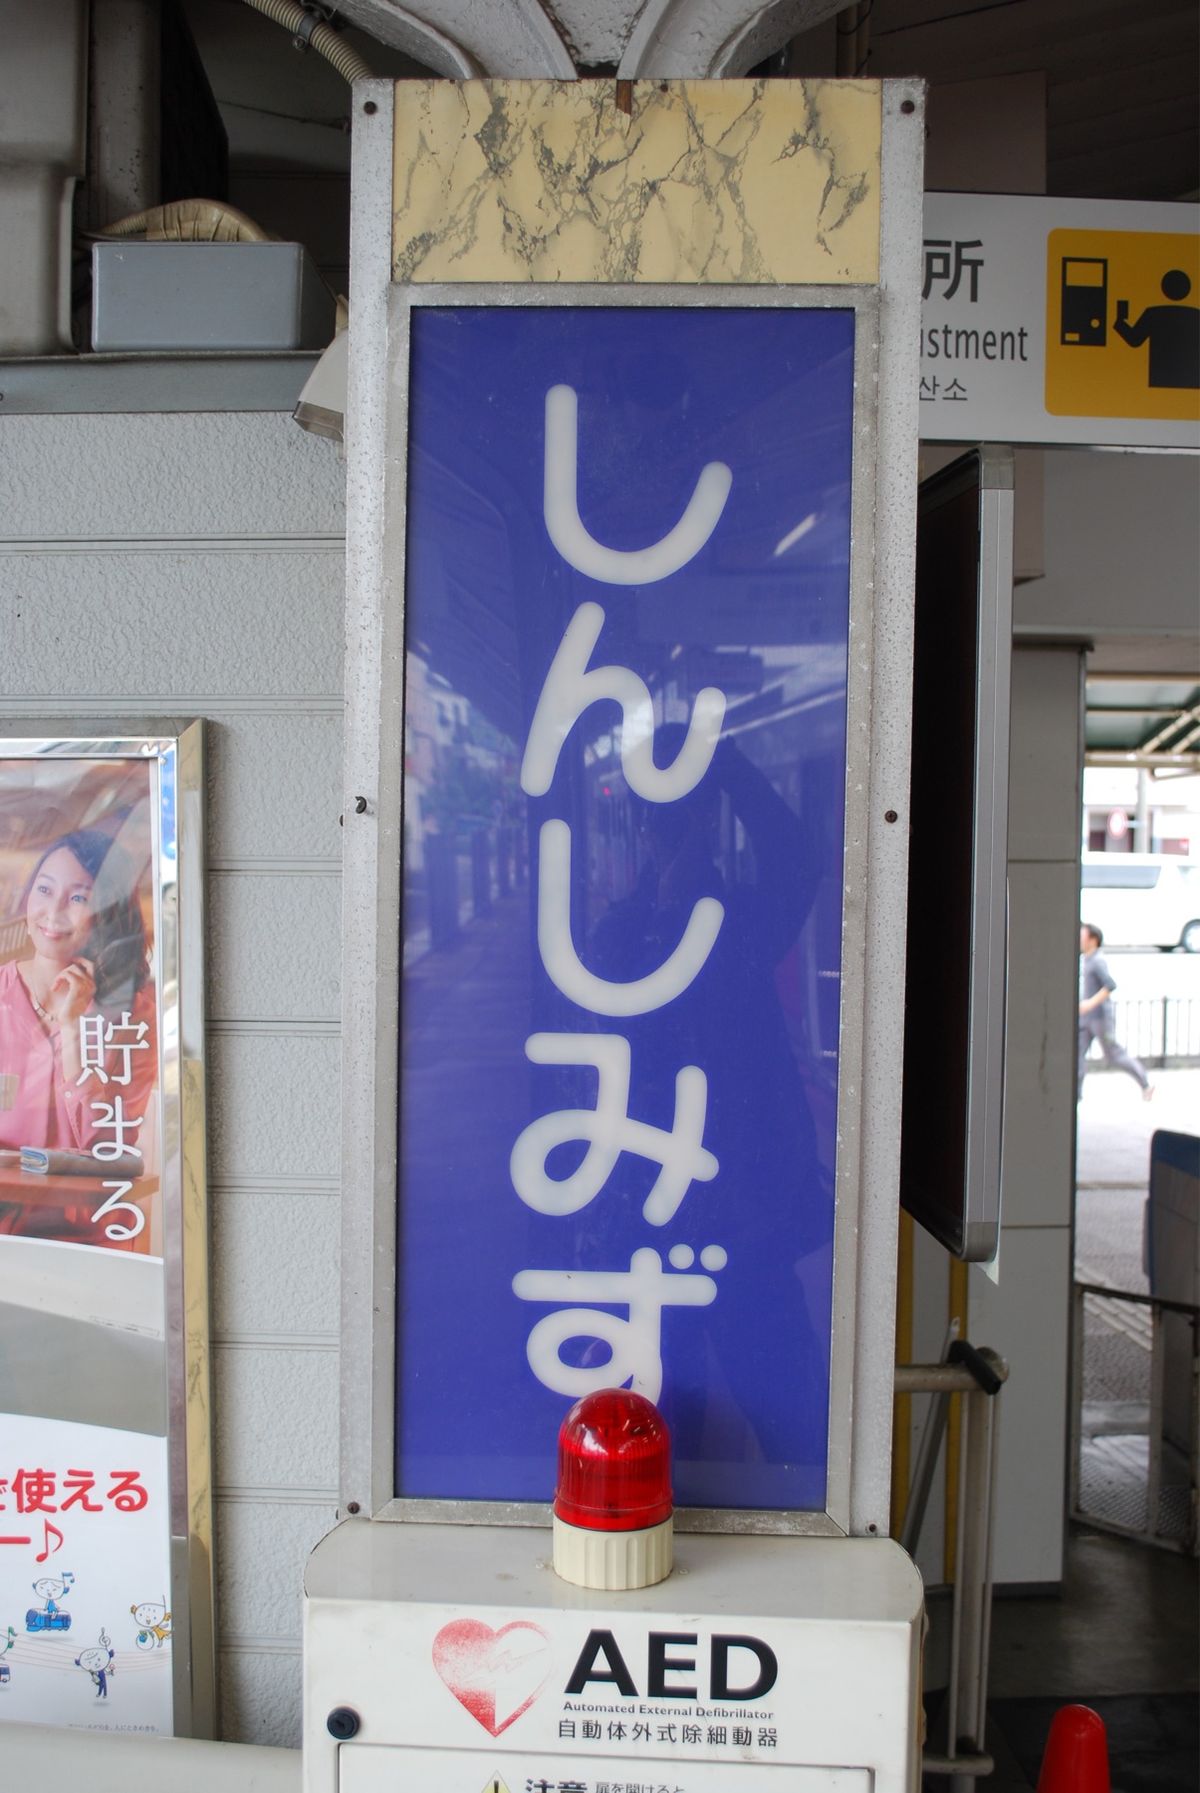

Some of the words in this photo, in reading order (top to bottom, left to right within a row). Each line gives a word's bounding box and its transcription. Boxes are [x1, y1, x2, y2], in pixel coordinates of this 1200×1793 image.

[920, 324, 1028, 361] stment
[510, 383, 729, 1406] しんしみず
[76, 1011, 150, 1241] 貯まる
[564, 1628, 779, 1701] AED
[559, 1718, 778, 1747] 自動体外式除細動器
[563, 1701, 635, 1714] Automated
[639, 1704, 692, 1716] External
[696, 1707, 774, 1719] Defibrillator
